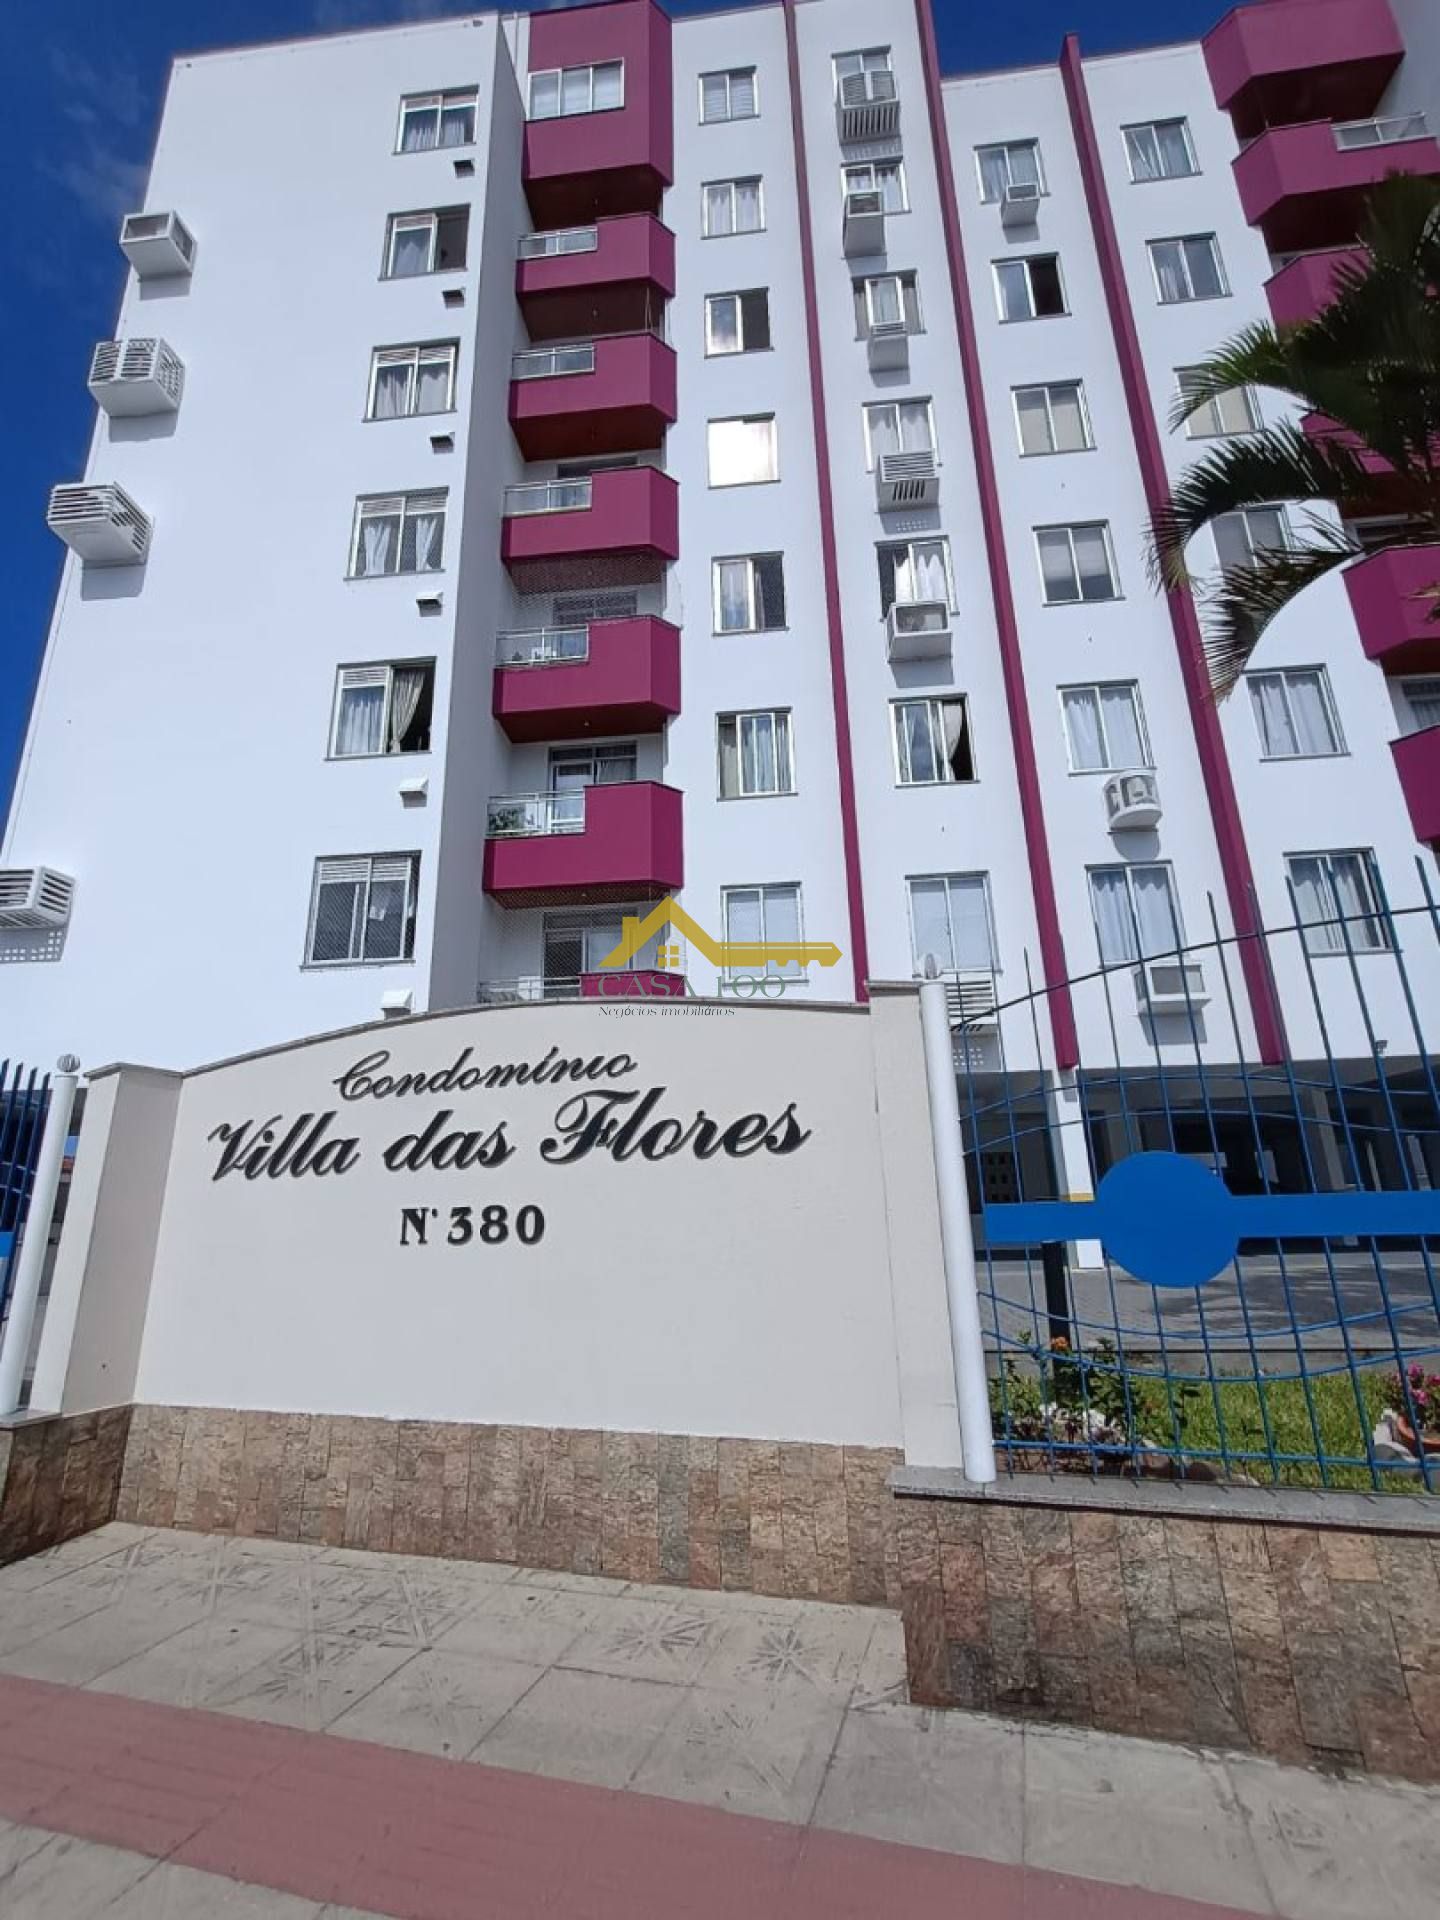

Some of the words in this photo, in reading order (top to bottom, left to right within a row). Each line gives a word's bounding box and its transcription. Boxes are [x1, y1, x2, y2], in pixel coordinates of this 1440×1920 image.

[207, 1110, 362, 1182] Villa
[382, 1109, 517, 1172] das
[540, 1086, 812, 1165] Flores
[447, 1204, 545, 1246] 380
